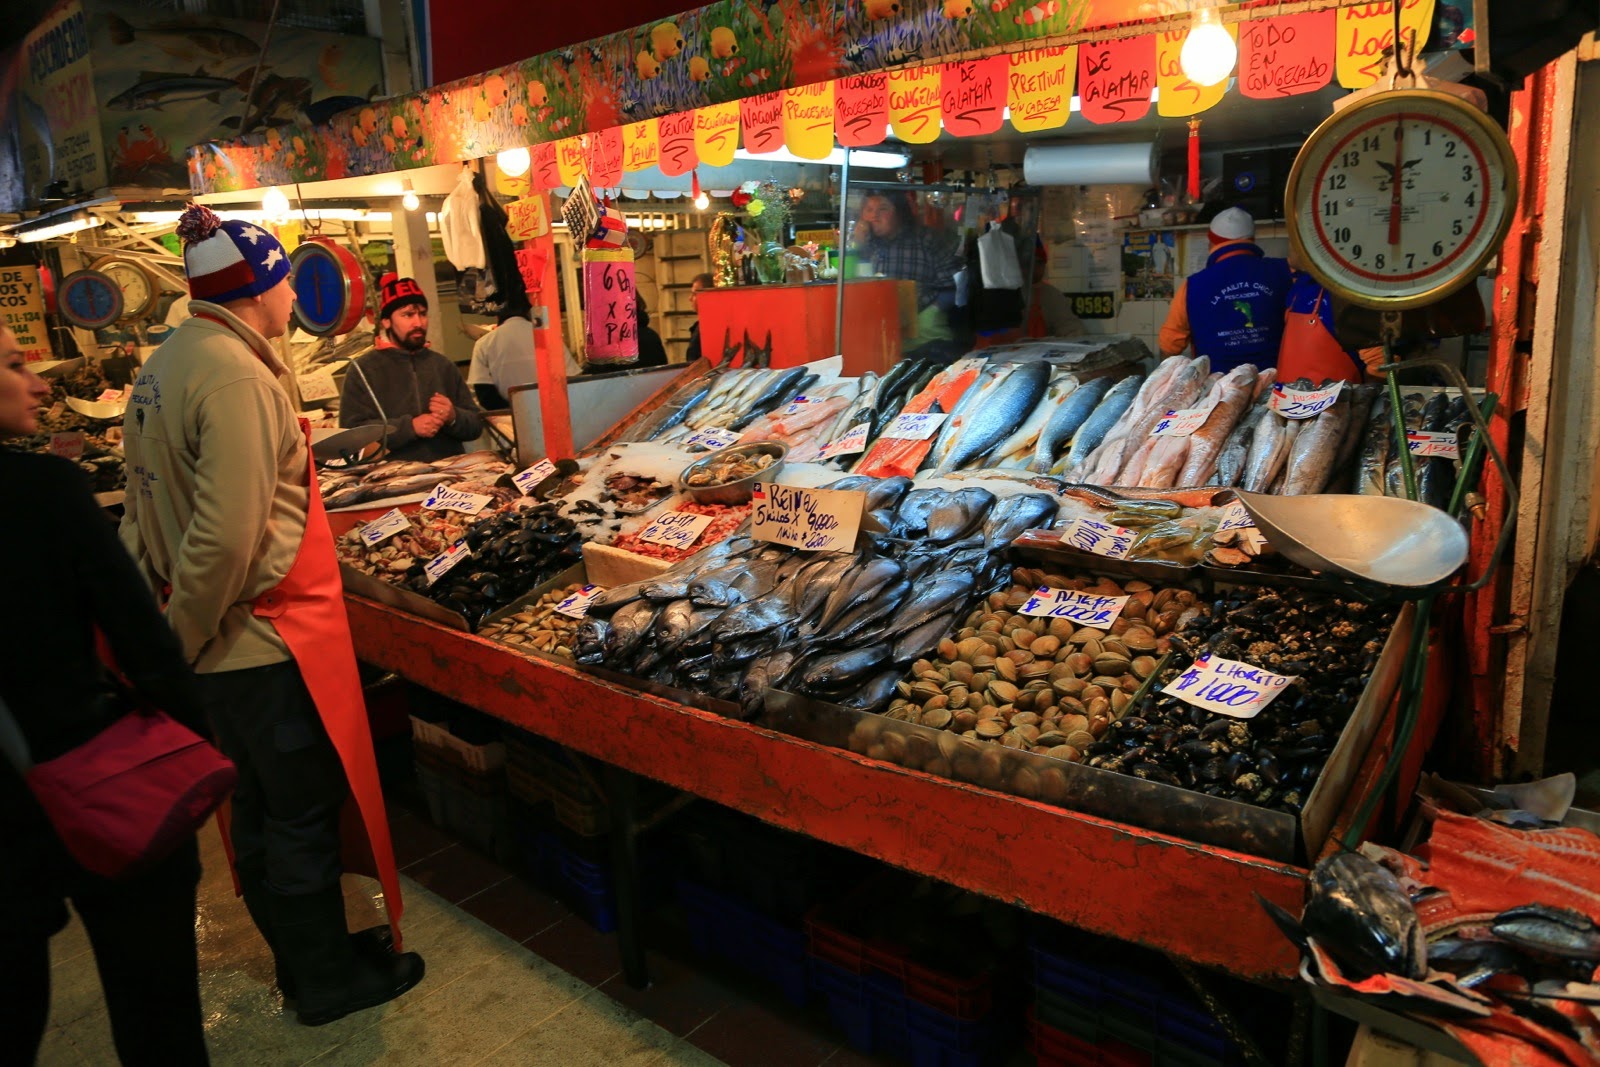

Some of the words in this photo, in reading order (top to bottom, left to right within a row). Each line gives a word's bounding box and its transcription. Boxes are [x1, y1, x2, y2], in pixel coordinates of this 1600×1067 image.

[1242, 25, 1296, 51] TODO
[1086, 51, 1111, 76] DE
[1250, 51, 1276, 71] EN
[960, 65, 977, 83] DE
[1247, 57, 1328, 91] CONGELADO
[1085, 70, 1149, 102] CALAMAR
[943, 77, 993, 114] CALAMAR
[635, 124, 647, 139] DE
[1424, 129, 1432, 145] 1
[1362, 136, 1380, 152] 14
[1445, 141, 1457, 158] 2
[1342, 151, 1360, 168] 13
[1329, 174, 1346, 190] 12
[1462, 165, 1473, 182] 3
[1464, 191, 1475, 208] 4
[1325, 201, 1338, 217] 11
[1334, 226, 1351, 243] 10
[1452, 219, 1463, 236] 5
[1352, 244, 1362, 260] 9
[1432, 241, 1444, 257] 6
[1374, 253, 1385, 270] 8
[1405, 253, 1416, 269] 7
[2, 271, 23, 283] DE
[23, 283, 33, 294] Y
[1076, 296, 1111, 314] 9583
[755, 504, 767, 525] 5
[1176, 669, 1202, 690] $
